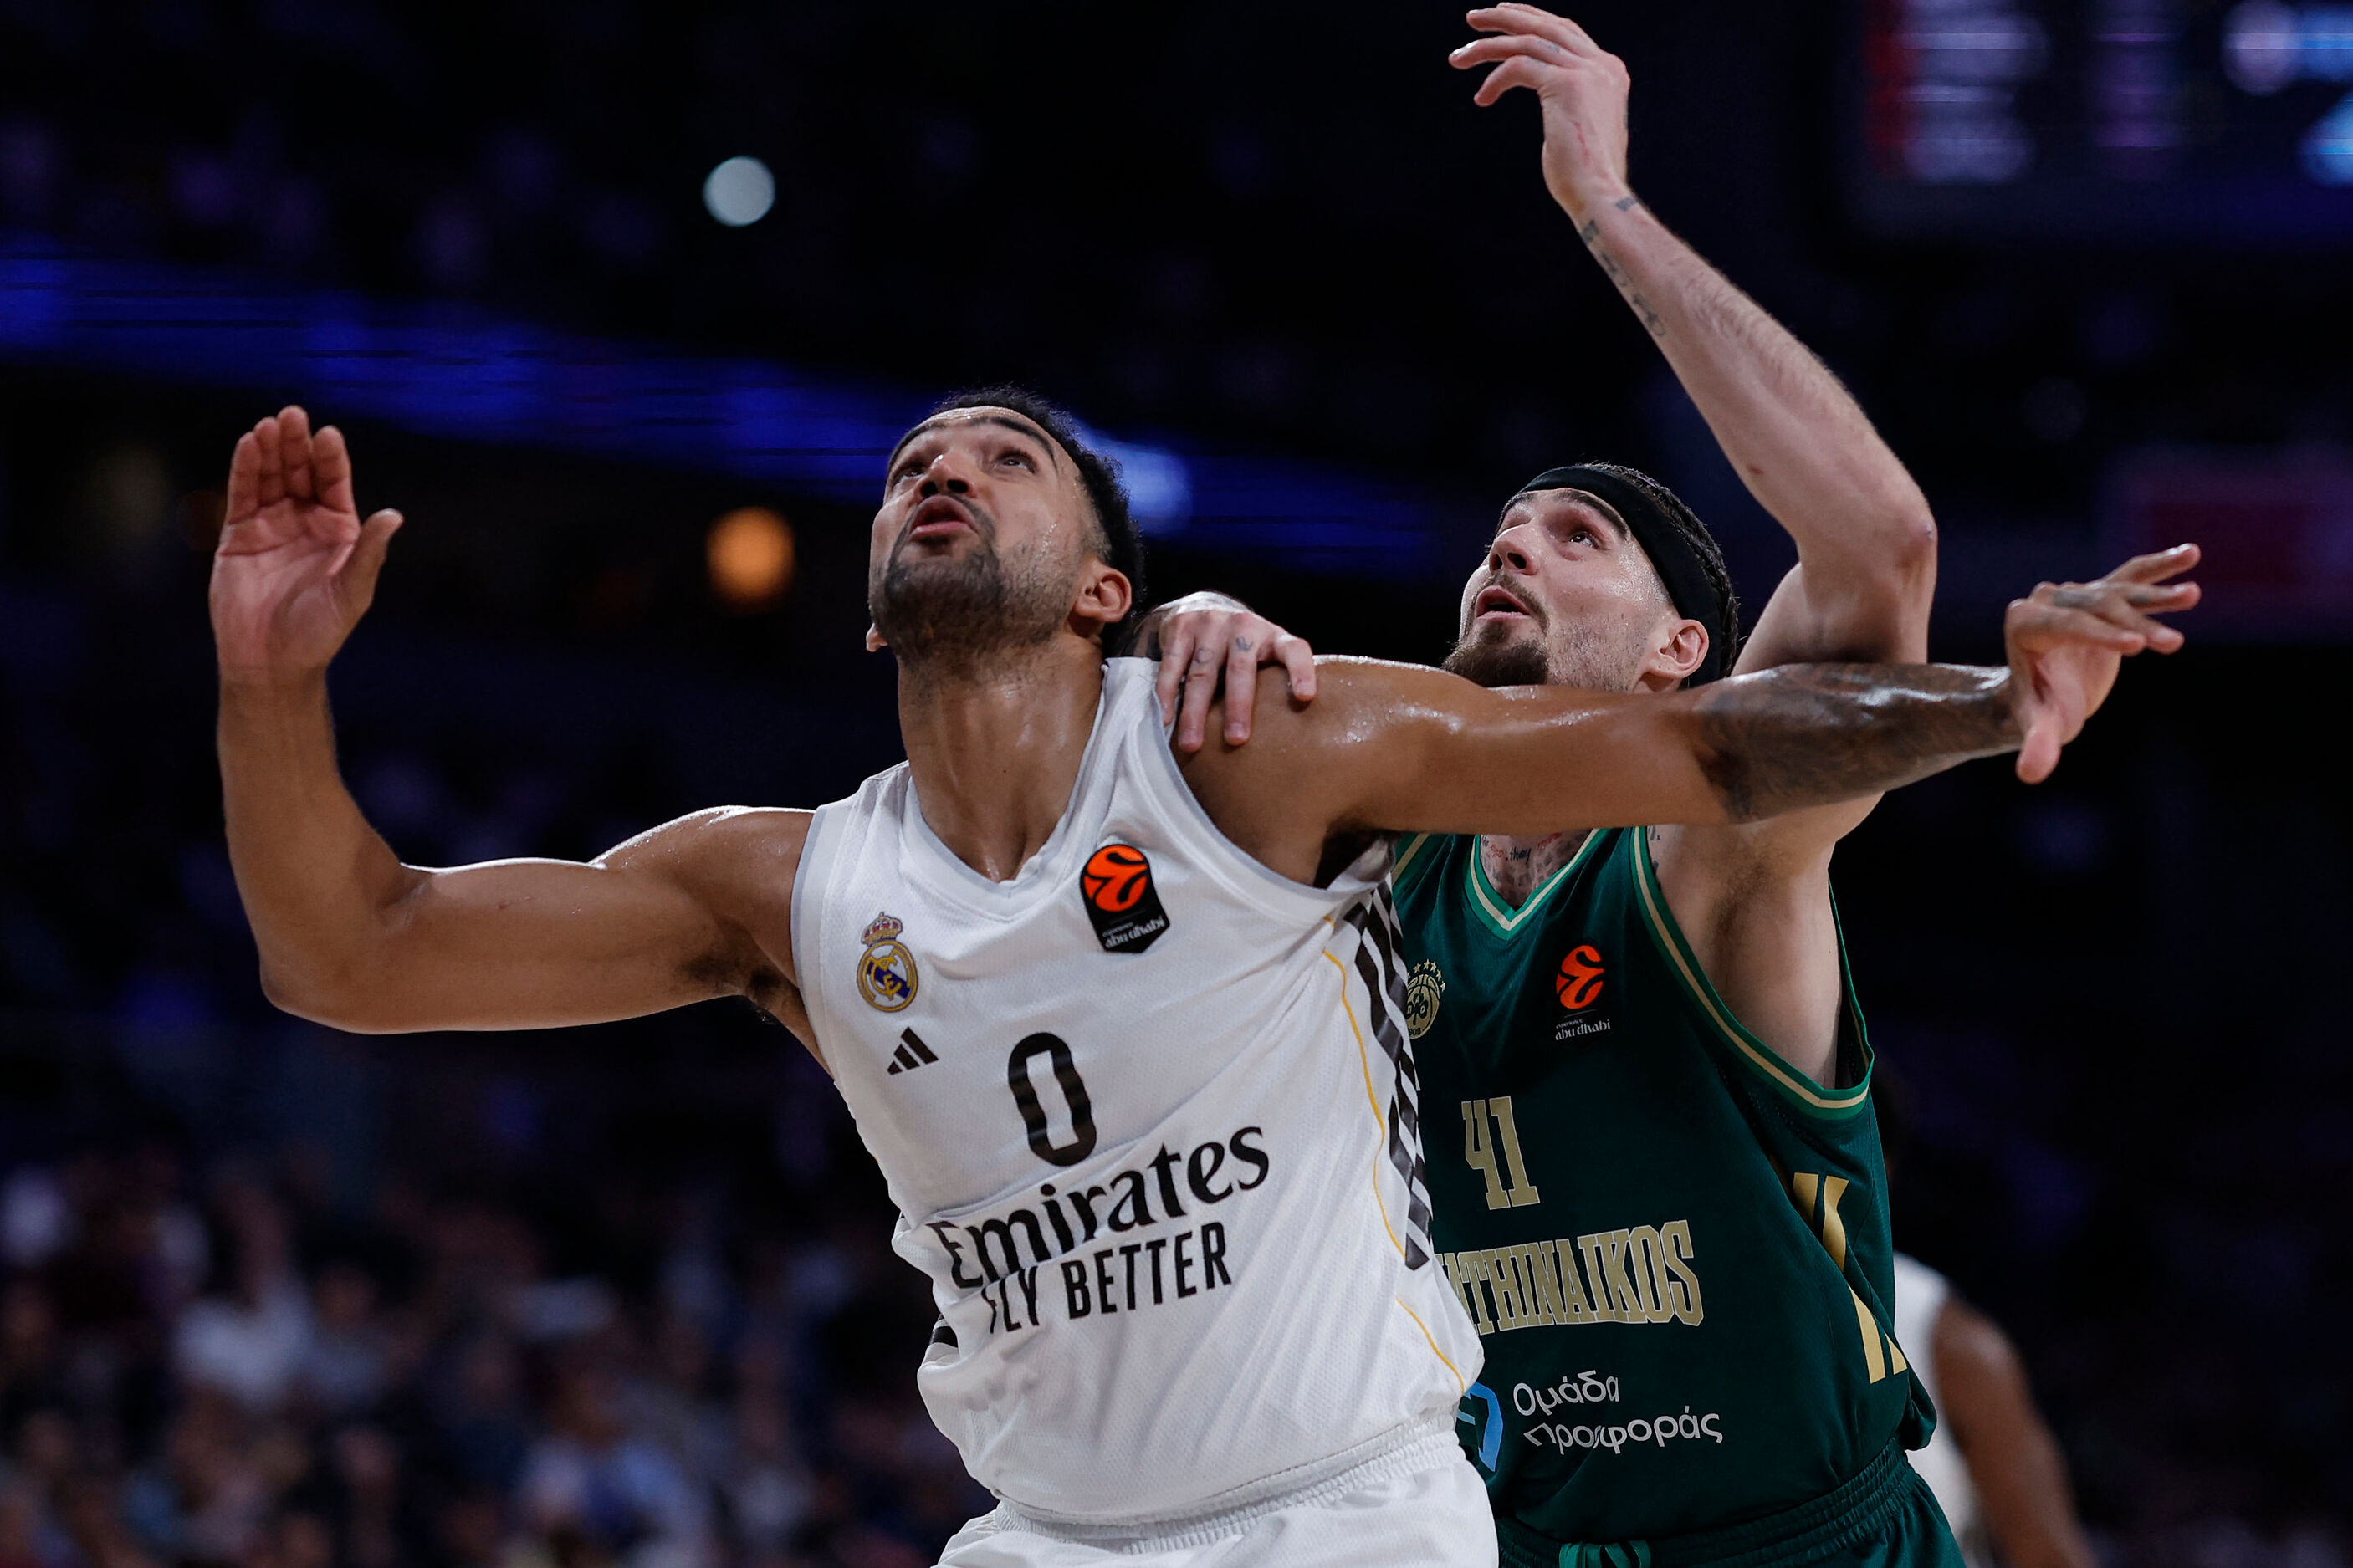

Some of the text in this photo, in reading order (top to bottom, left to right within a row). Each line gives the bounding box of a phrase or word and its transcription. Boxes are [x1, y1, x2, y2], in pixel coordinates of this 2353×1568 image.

[1555, 1018, 1611, 1041] abu dhabi
[1008, 1032, 1097, 1167] 0
[1461, 1096, 1541, 1210] 41
[926, 1126, 1270, 1289] Emirates
[1060, 1222, 1232, 1320] BETTER
[1512, 1370, 1620, 1417] Ομάδα
